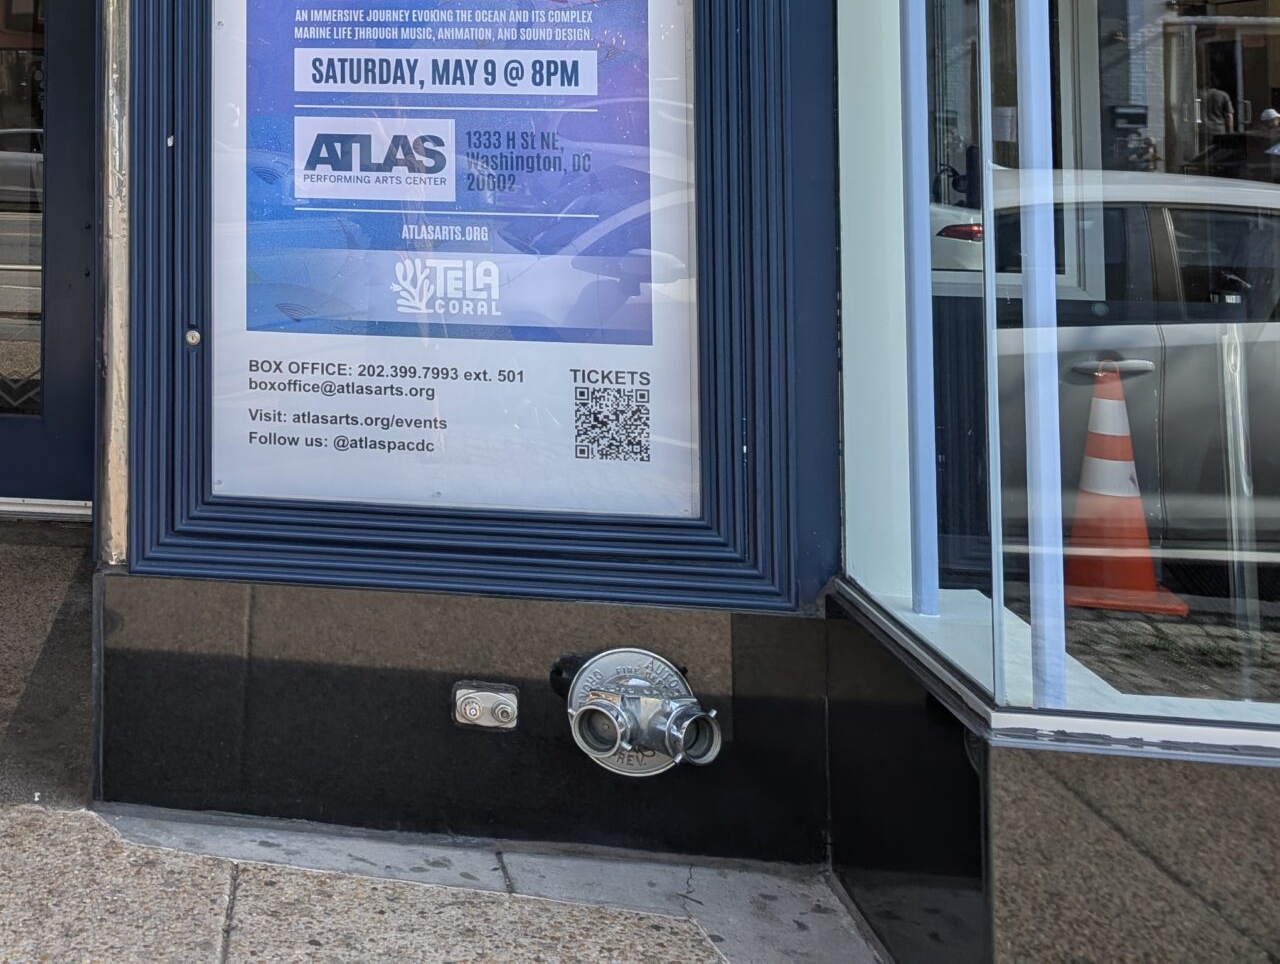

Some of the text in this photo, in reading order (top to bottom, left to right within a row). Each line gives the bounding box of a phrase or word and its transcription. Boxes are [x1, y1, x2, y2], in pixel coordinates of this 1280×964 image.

[295, 9, 593, 24] AN IMMERSIVE JOURNEY EVOKING THE OCEAN AND ITS COMPLEX
[294, 26, 594, 42] MARINE LIFE THROUGH MUSIC, ANIMATION, AND SOUND DESIGN.
[311, 57, 579, 90] SATURDAY, MAY 9 @ 8PM
[466, 130, 502, 149] 1333
[506, 131, 516, 150] H
[520, 131, 536, 150] St
[303, 133, 447, 175] ATLAS
[466, 151, 592, 174] Washington, DC
[303, 174, 447, 186] PERFORMING ARTS CENTER
[401, 224, 489, 241] ATLASARTS.ORG
[425, 259, 500, 300] TELA
[435, 299, 502, 316] CORAL
[248, 359, 524, 383] BOX OFFICE: 202.399.7993 ext. 501
[568, 368, 651, 386] TICKETS
[248, 377, 435, 401] boxoffice@atlasarts.org
[248, 408, 448, 430] Visit: atlasarts.org/events
[248, 431, 435, 453] Follow us: @atlaspacdc
